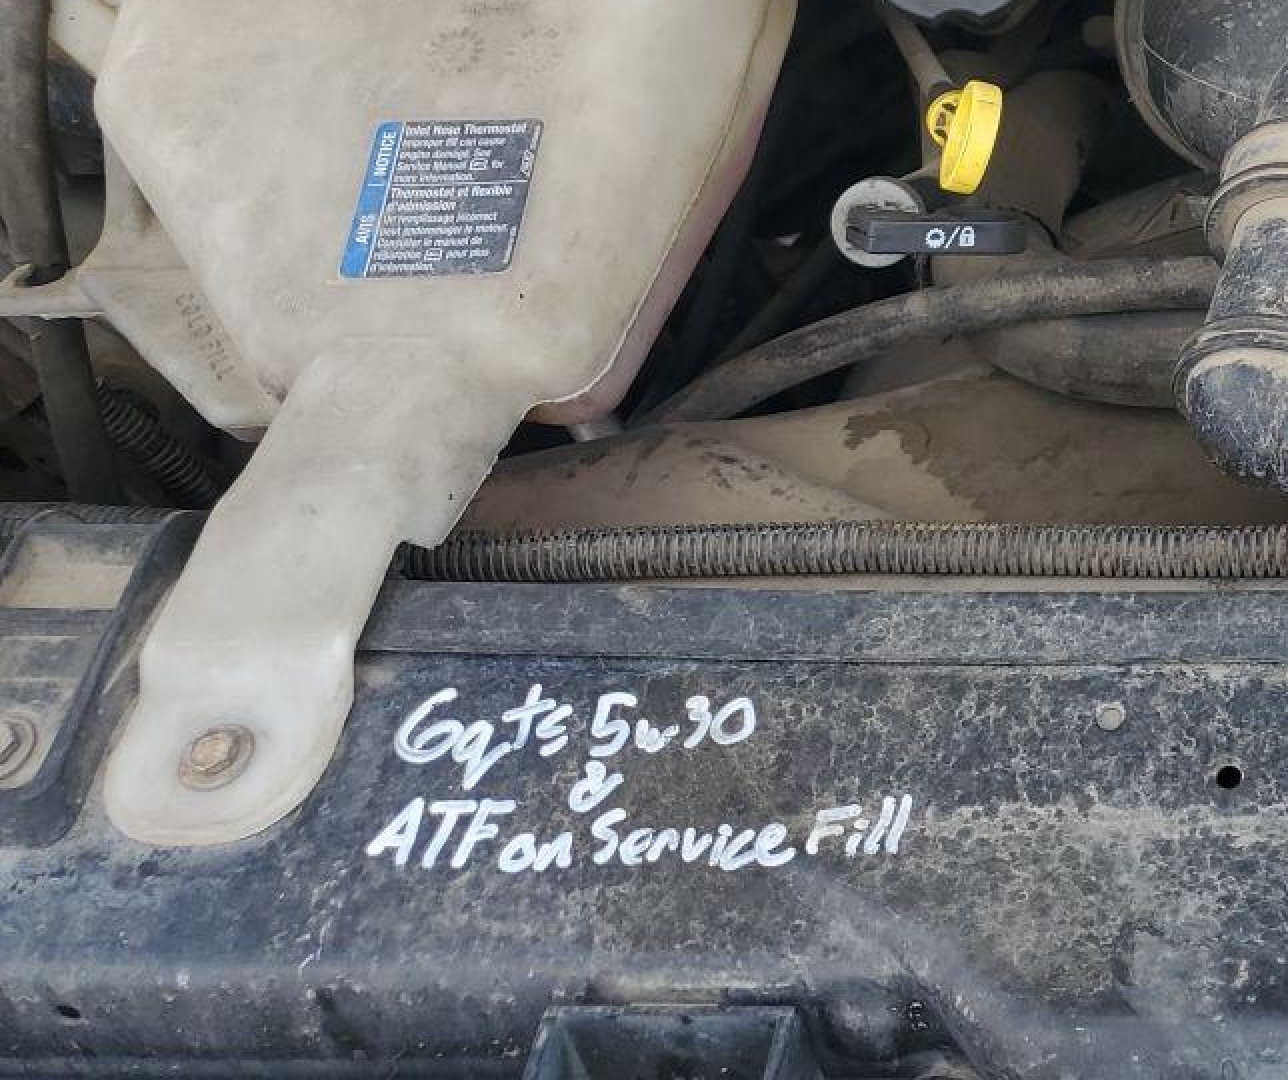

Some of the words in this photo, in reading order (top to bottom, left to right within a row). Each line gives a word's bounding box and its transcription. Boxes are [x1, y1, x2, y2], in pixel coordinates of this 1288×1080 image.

[464, 123, 527, 134] Thermostat
[373, 131, 397, 177] NOTICE
[365, 796, 517, 870] ATF
[500, 830, 573, 873] on
[591, 808, 796, 872] Service
[806, 792, 914, 856] Fill
